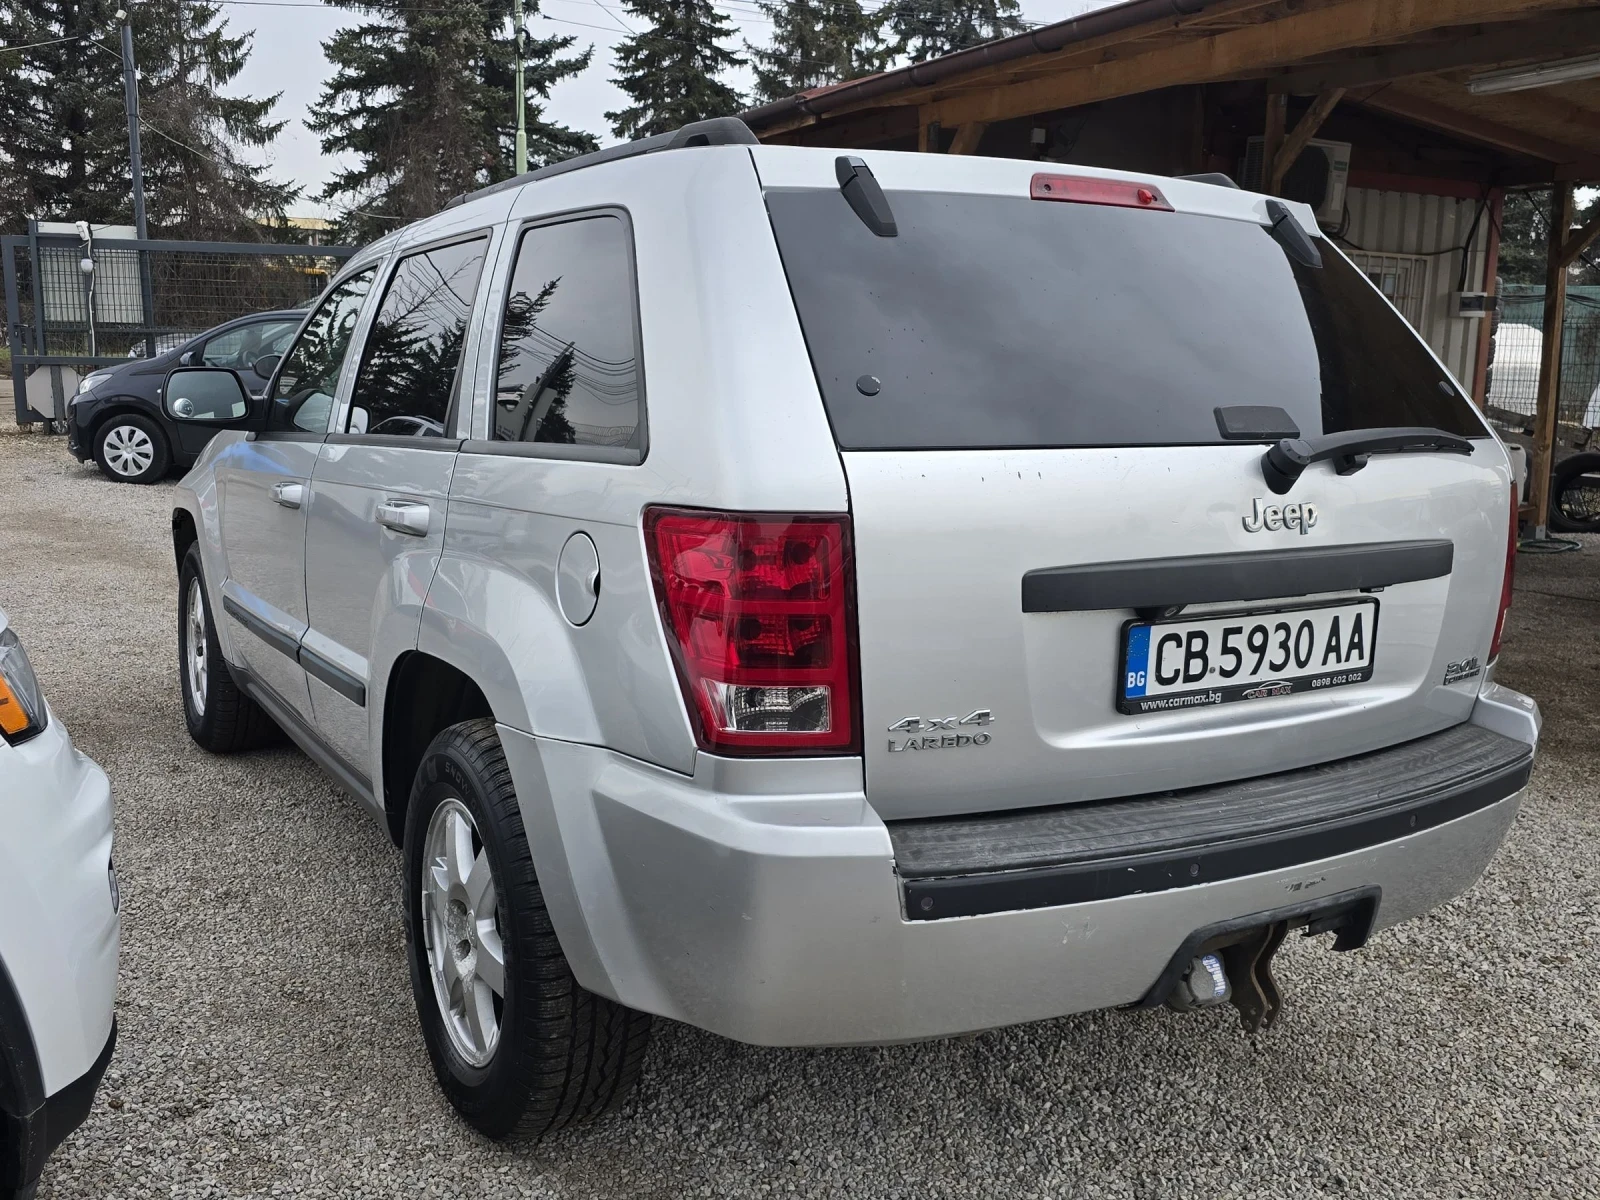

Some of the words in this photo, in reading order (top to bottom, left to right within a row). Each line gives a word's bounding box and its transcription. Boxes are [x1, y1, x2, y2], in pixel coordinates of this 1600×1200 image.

[1242, 497, 1318, 535] Jeep
[1155, 630, 1209, 686] CB
[1219, 619, 1314, 678] 5930
[1321, 612, 1364, 666] AA
[1127, 671, 1145, 688] BG
[1311, 677, 1331, 688] 0898
[1332, 675, 1347, 684] 602
[1348, 673, 1362, 682] 002
[1141, 691, 1222, 710] www.carmax.bg
[1247, 688, 1268, 699] CAR
[1271, 686, 1292, 696] MAX
[888, 732, 992, 752] LAREDO
